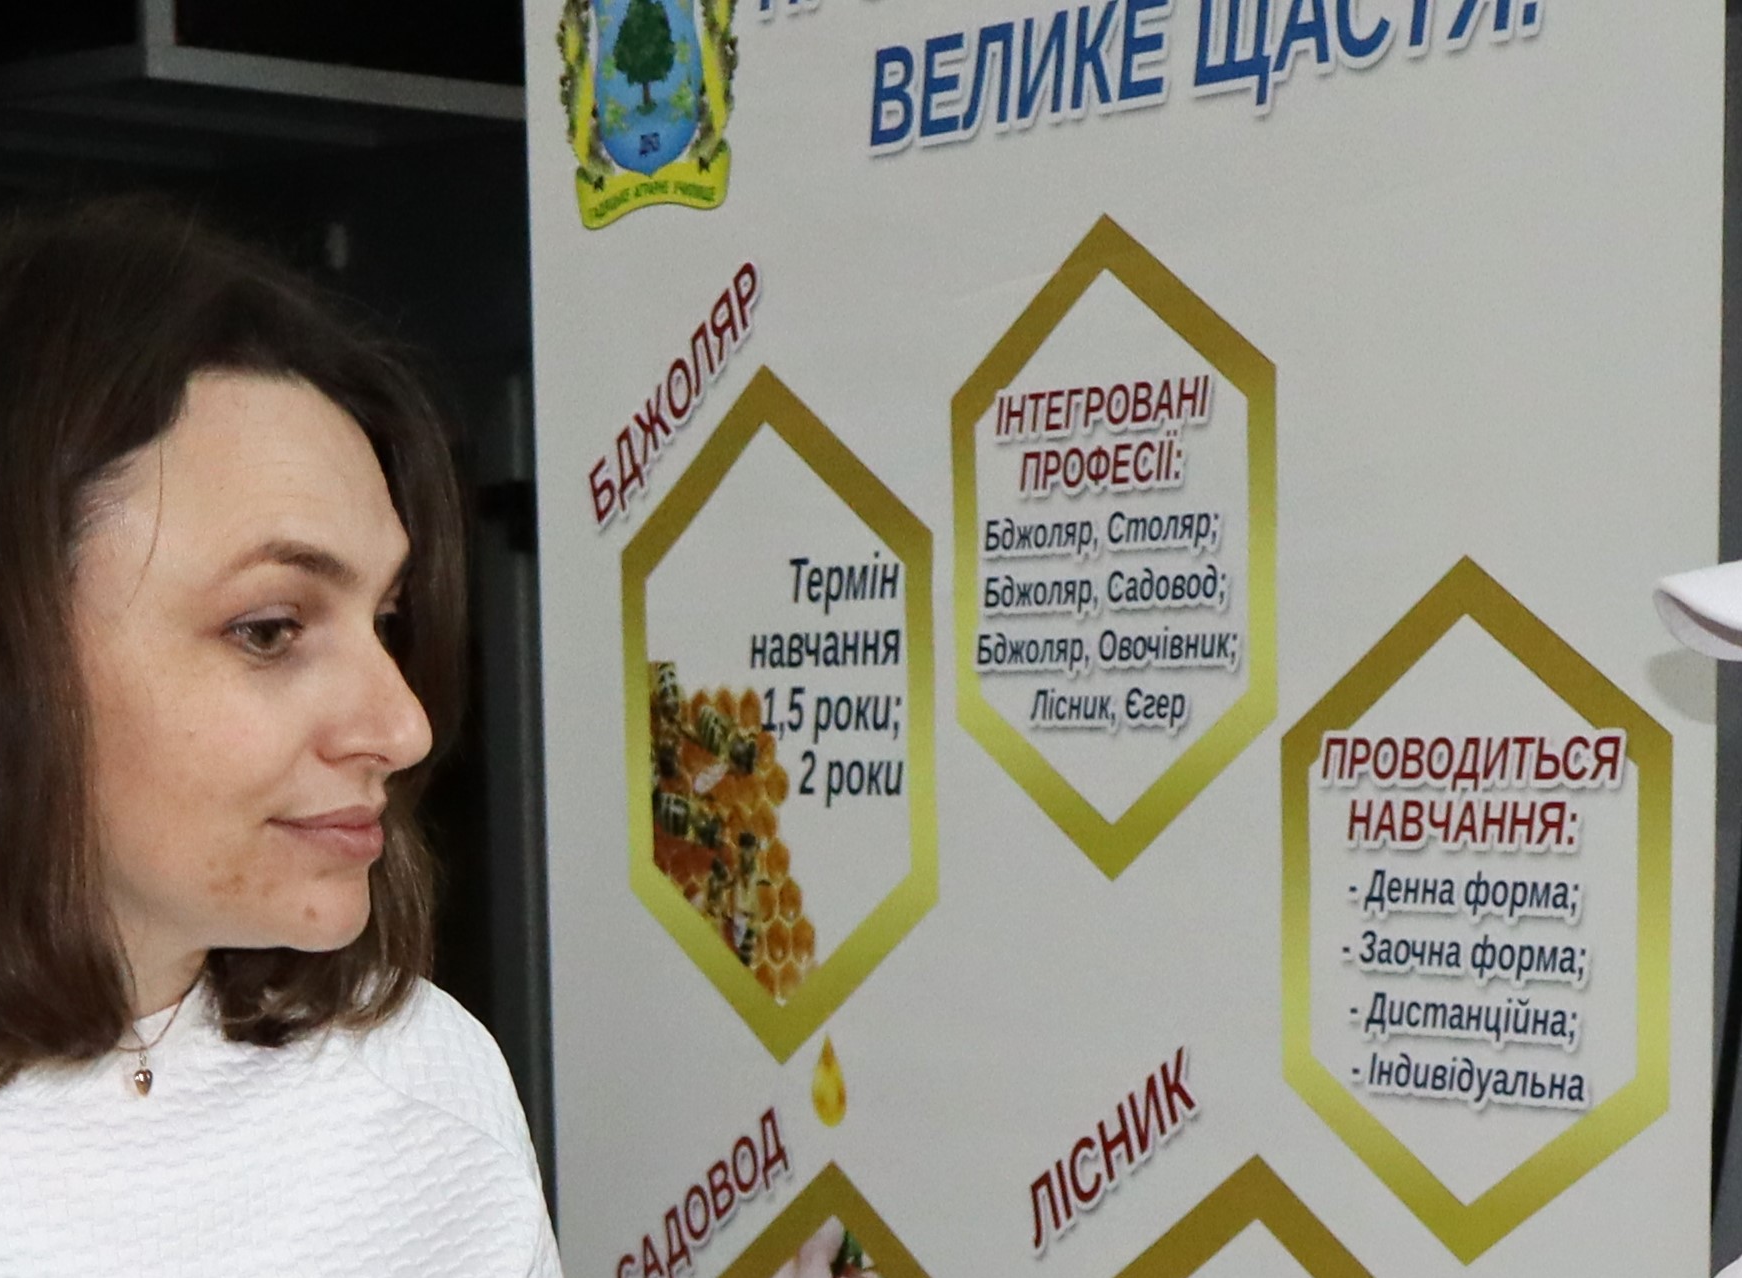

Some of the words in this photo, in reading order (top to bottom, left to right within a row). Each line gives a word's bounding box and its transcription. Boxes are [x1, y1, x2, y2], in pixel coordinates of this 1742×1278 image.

[869, 0, 1167, 147] ВЕЛИКЕ
[589, 262, 758, 524] БДЖОЛЯР
[996, 375, 1209, 435] ІНТЕГРОВАНІ
[1020, 430, 1182, 491] ПРОФЕСІЇ:
[984, 518, 1098, 553] Бджоляр,
[1108, 511, 1219, 548] Столяр;
[789, 552, 900, 614] Термін
[984, 576, 1098, 613] Бджоляр,
[1108, 564, 1226, 604] Садовод;
[750, 628, 901, 669] навчання
[977, 632, 1089, 670] Бджоляр,
[1098, 626, 1237, 663] Овочівник;
[762, 687, 805, 742] 1,5
[814, 690, 902, 742] роки;
[1031, 687, 1115, 726] Лісник,
[1125, 687, 1185, 728] Єгер
[799, 751, 816, 796] 2
[826, 758, 903, 807] роки
[1322, 736, 1621, 791] ПРОВОДИТЬСЯ
[1347, 799, 1578, 846] НАВЧАННЯ:
[1364, 870, 1455, 912] Денна
[1464, 871, 1579, 916] форма;
[1359, 930, 1461, 968] Заочна
[1471, 934, 1587, 981] форма;
[1365, 992, 1578, 1043] Дистанційна;
[1368, 1053, 1585, 1102] Індивідуальна
[1028, 1046, 1197, 1249] ЛІСНИК
